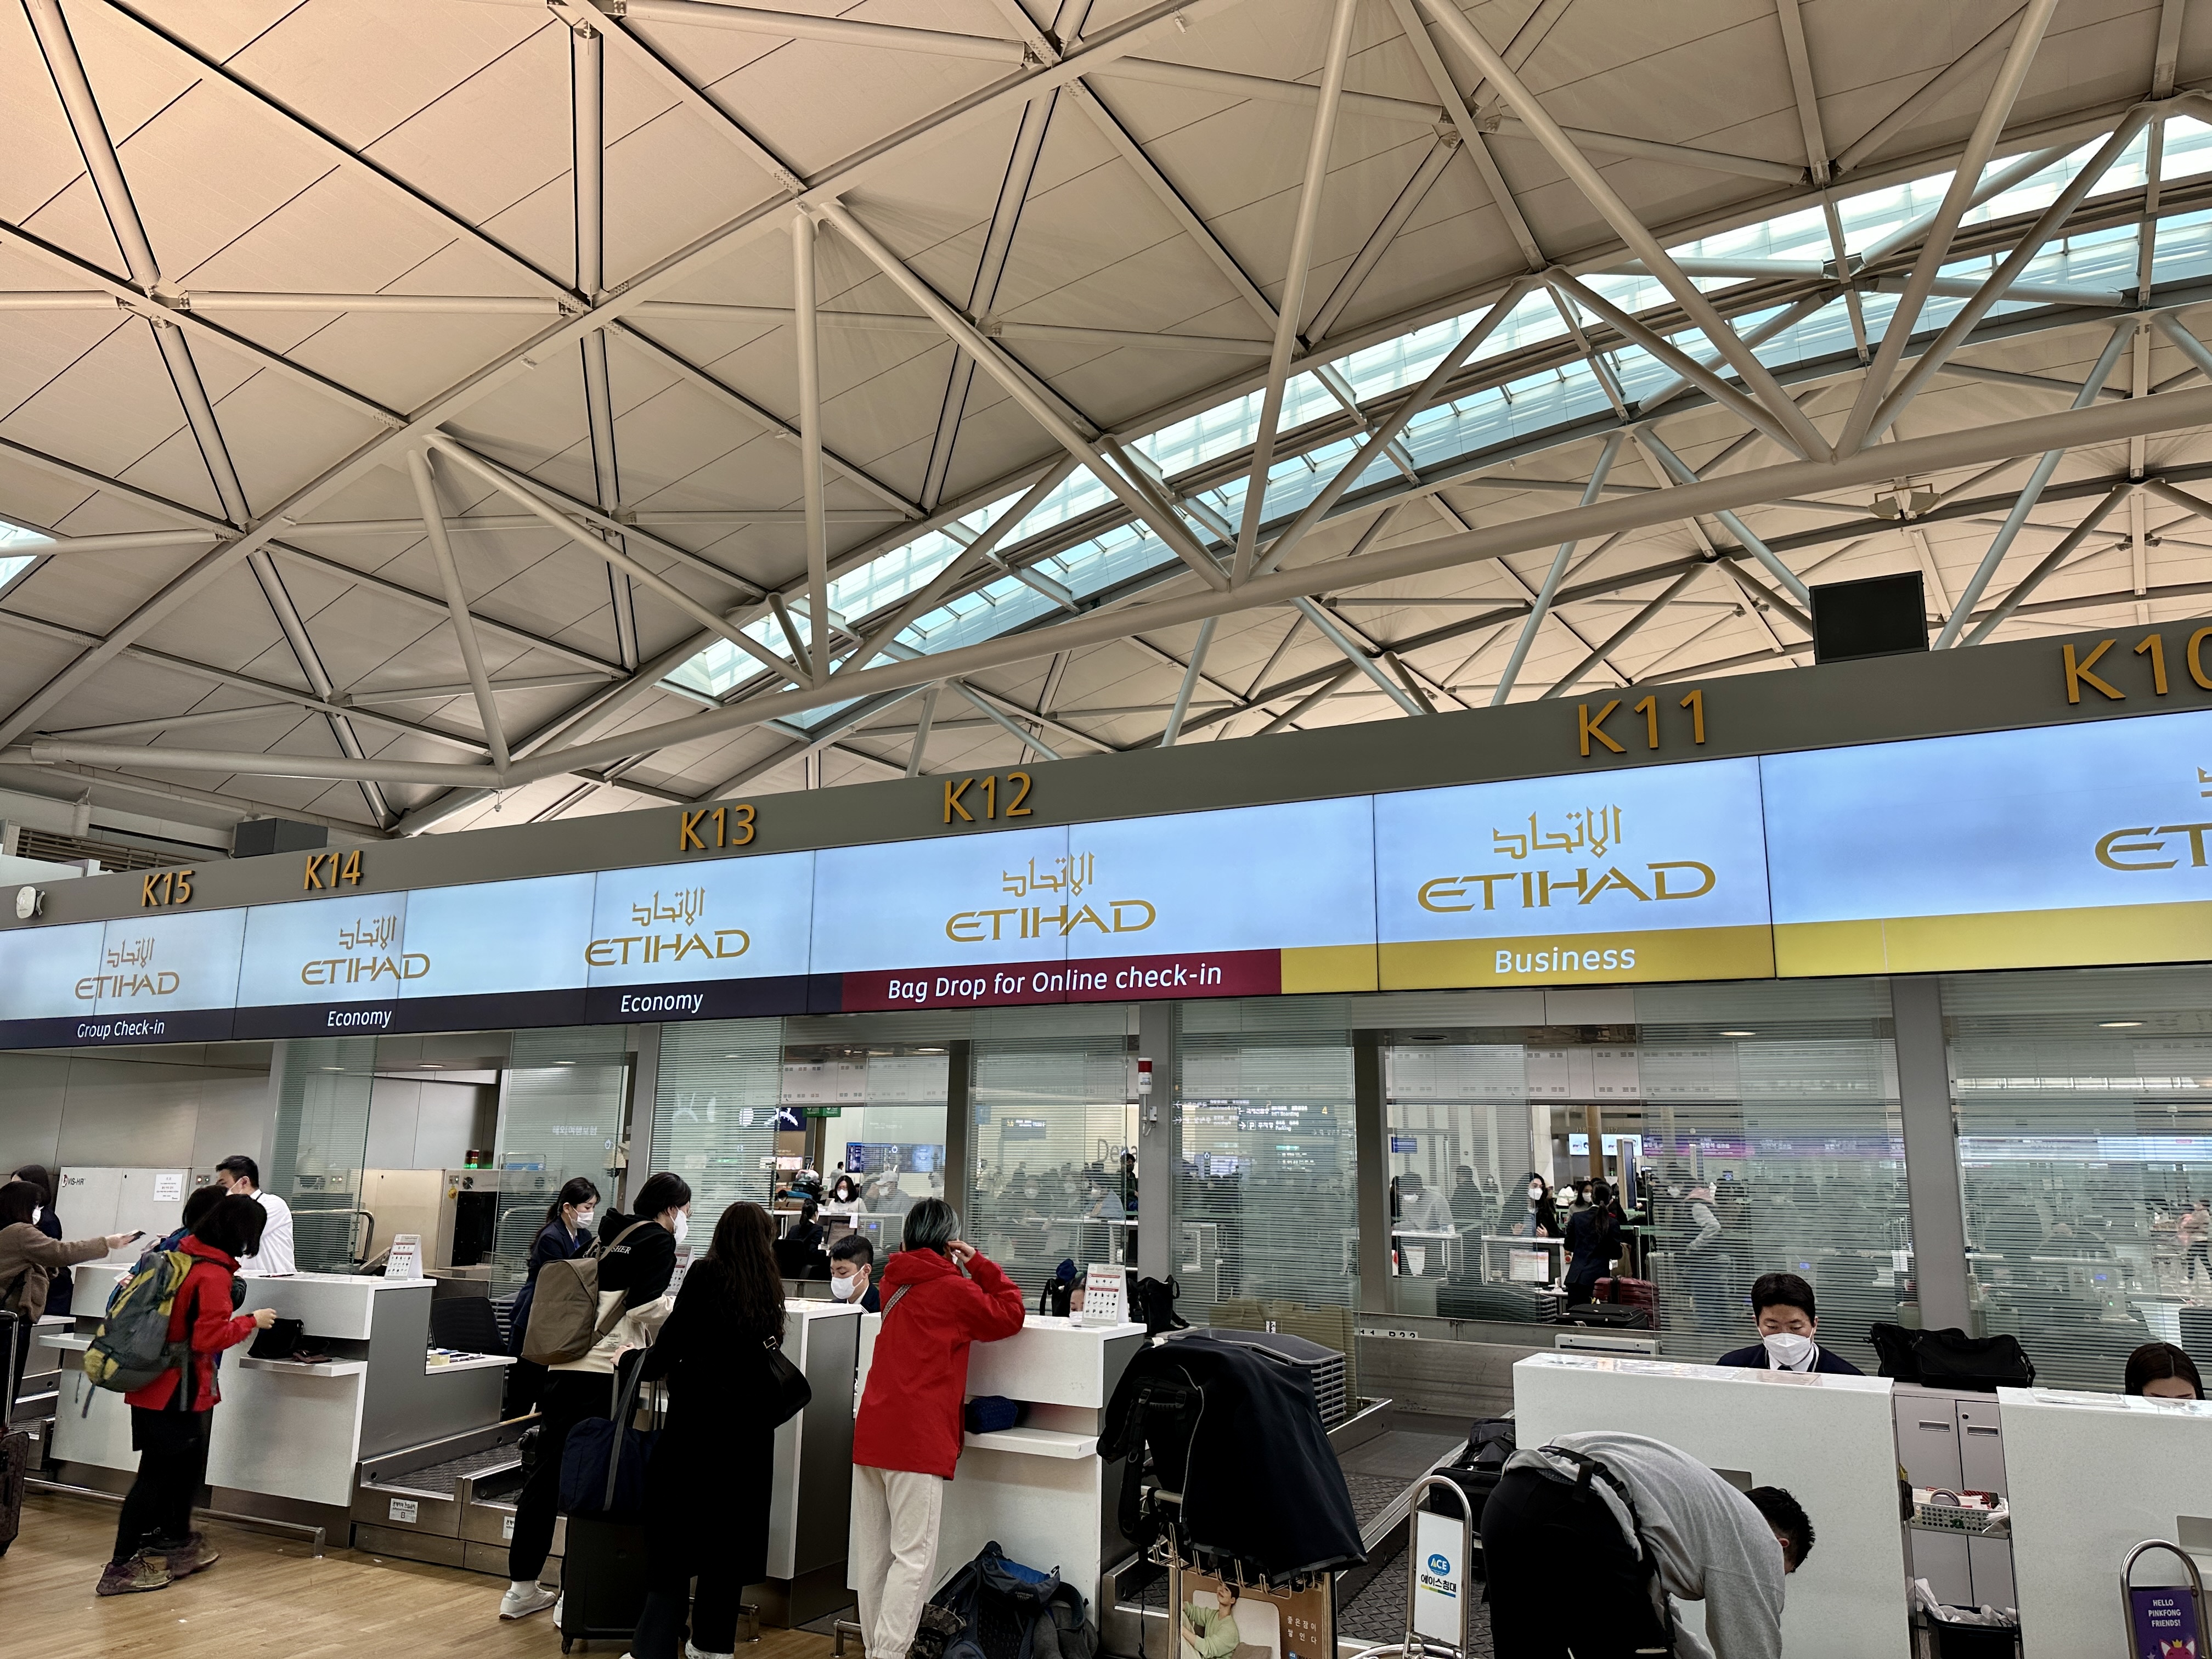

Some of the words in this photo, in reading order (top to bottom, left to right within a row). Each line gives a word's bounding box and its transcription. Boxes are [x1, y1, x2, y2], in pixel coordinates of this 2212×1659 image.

[1578, 689, 1705, 757] K11
[944, 771, 1034, 824] K12
[680, 804, 757, 851] K13
[303, 850, 362, 890] K14
[141, 870, 195, 907] K15
[1417, 861, 1717, 913] ETIHAD
[945, 899, 1156, 943] ETIHAD
[585, 929, 750, 967] ETIHAD
[1495, 945, 1636, 974] Business
[301, 953, 431, 985] ETIHAD
[888, 979, 928, 1003] Bag
[935, 976, 986, 1000] Drop
[994, 972, 1023, 994] for
[1032, 968, 1107, 993] Online
[1115, 963, 1222, 990] check-in
[75, 972, 180, 1000] ETIHAD
[620, 991, 704, 1014] Economy
[77, 1022, 111, 1040] Group
[114, 1019, 165, 1037] Check-in
[327, 1009, 392, 1030] Economy
[1430, 1558, 1447, 1571] ACE
[1420, 1574, 1457, 1593] 에이스침대
[2148, 1609, 2181, 1617] PINKFONG
[2152, 1599, 2174, 1607] HELLO
[2151, 1619, 2181, 1628] FRIENDS!
